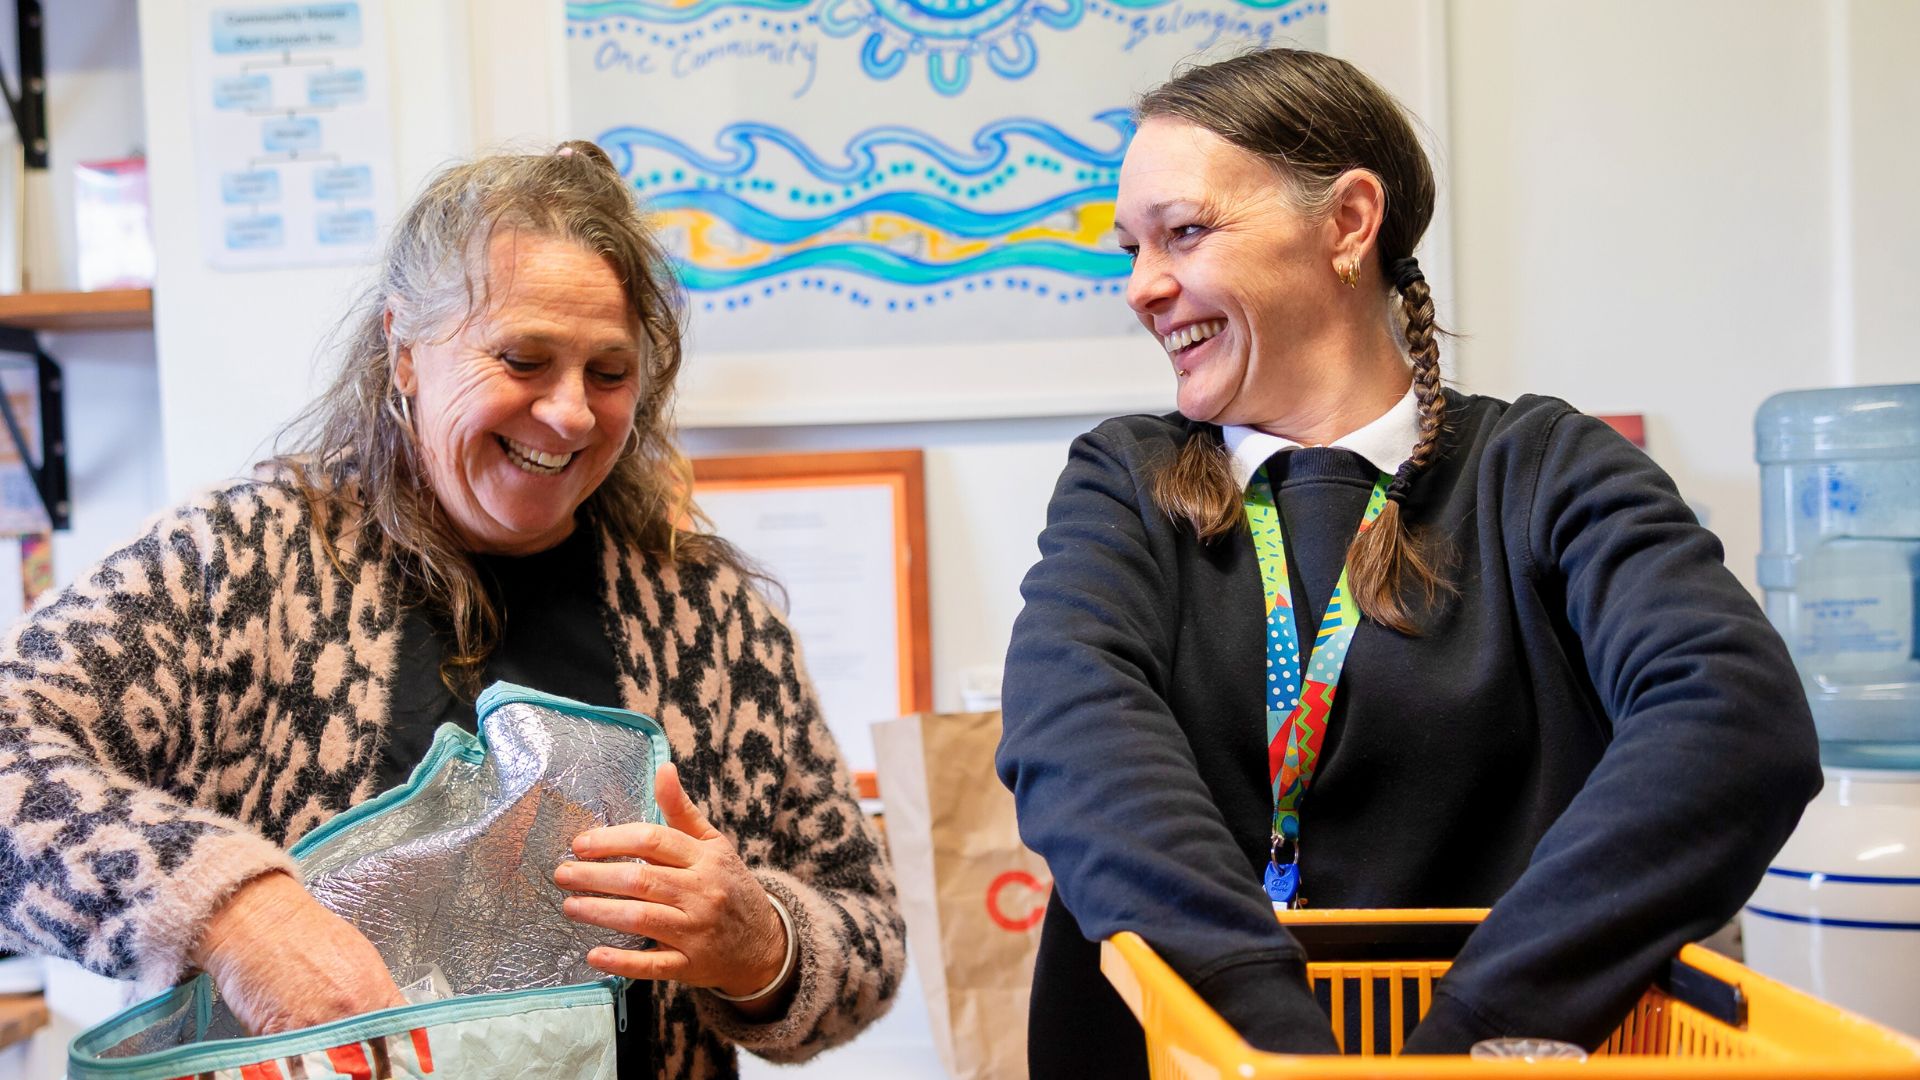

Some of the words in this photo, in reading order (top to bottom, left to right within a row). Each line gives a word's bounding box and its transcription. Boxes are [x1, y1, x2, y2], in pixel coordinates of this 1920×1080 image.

[1122, 3, 1274, 52] Belonging
[594, 39, 656, 75] One
[671, 39, 819, 100] Community
[986, 869, 1054, 933] C
